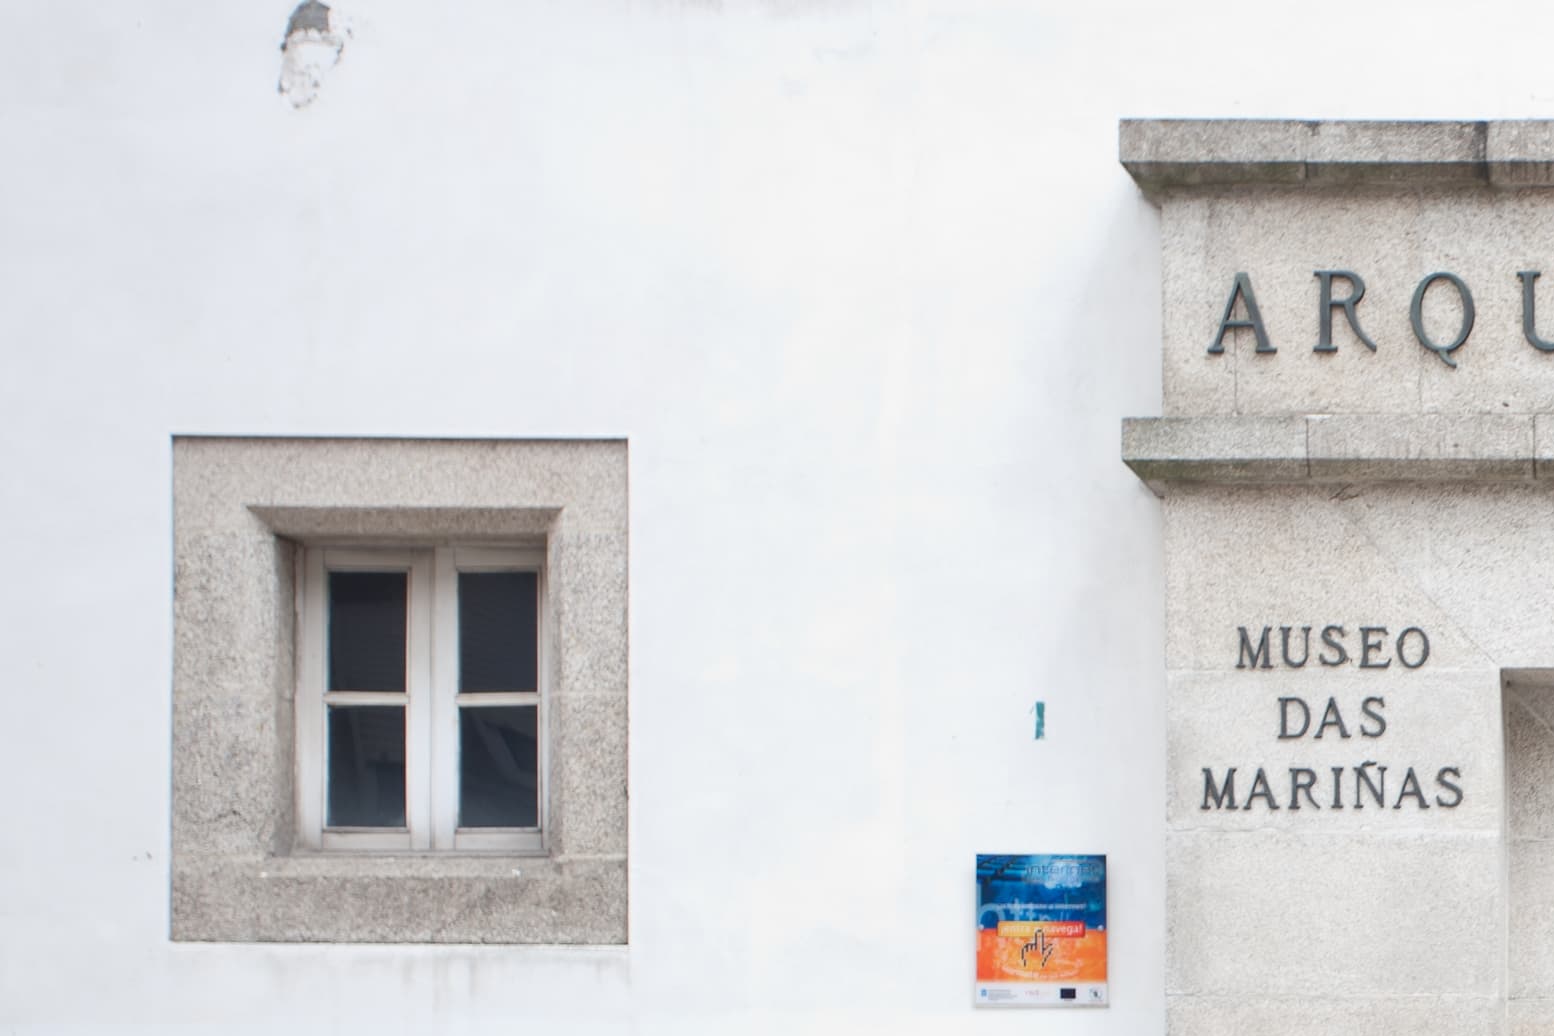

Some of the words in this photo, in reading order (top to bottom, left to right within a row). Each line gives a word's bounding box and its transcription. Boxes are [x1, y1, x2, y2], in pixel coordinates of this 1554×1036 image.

[1235, 625, 1430, 672] MUSEO
[1277, 697, 1386, 740] DAS
[1200, 761, 1463, 811] MARIÑAS
